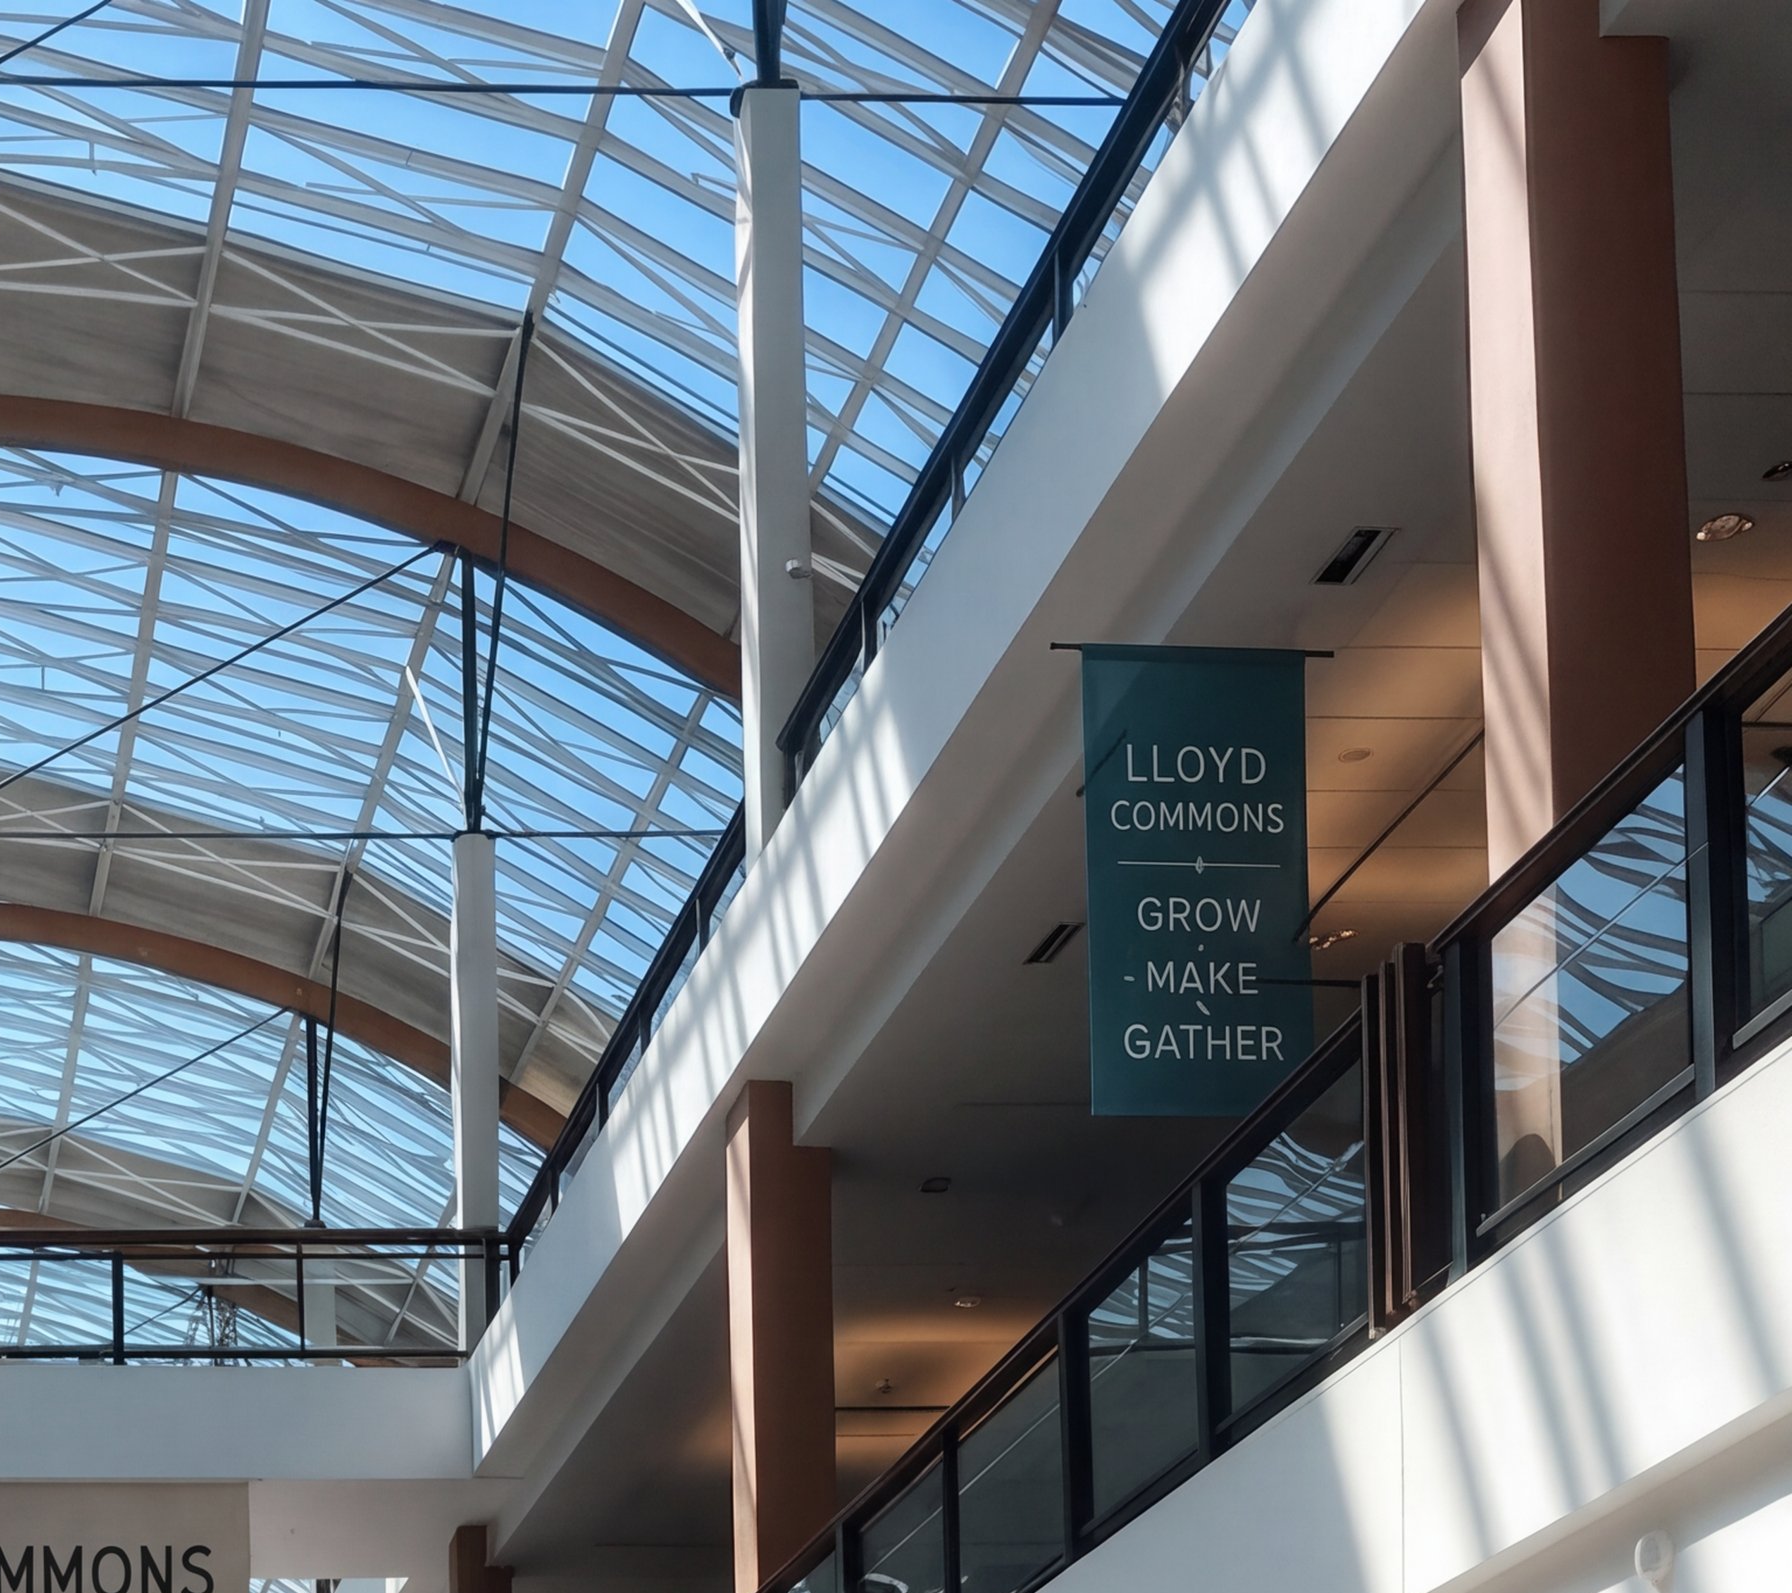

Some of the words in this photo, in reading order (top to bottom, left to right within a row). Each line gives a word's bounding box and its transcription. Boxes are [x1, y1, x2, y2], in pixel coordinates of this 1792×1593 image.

[1125, 743, 1267, 785] LLOYD
[1110, 800, 1285, 833] COMMONS
[1137, 897, 1261, 932] GROW
[1147, 961, 1259, 995] MAKE
[1124, 1024, 1284, 1061] GATHER
